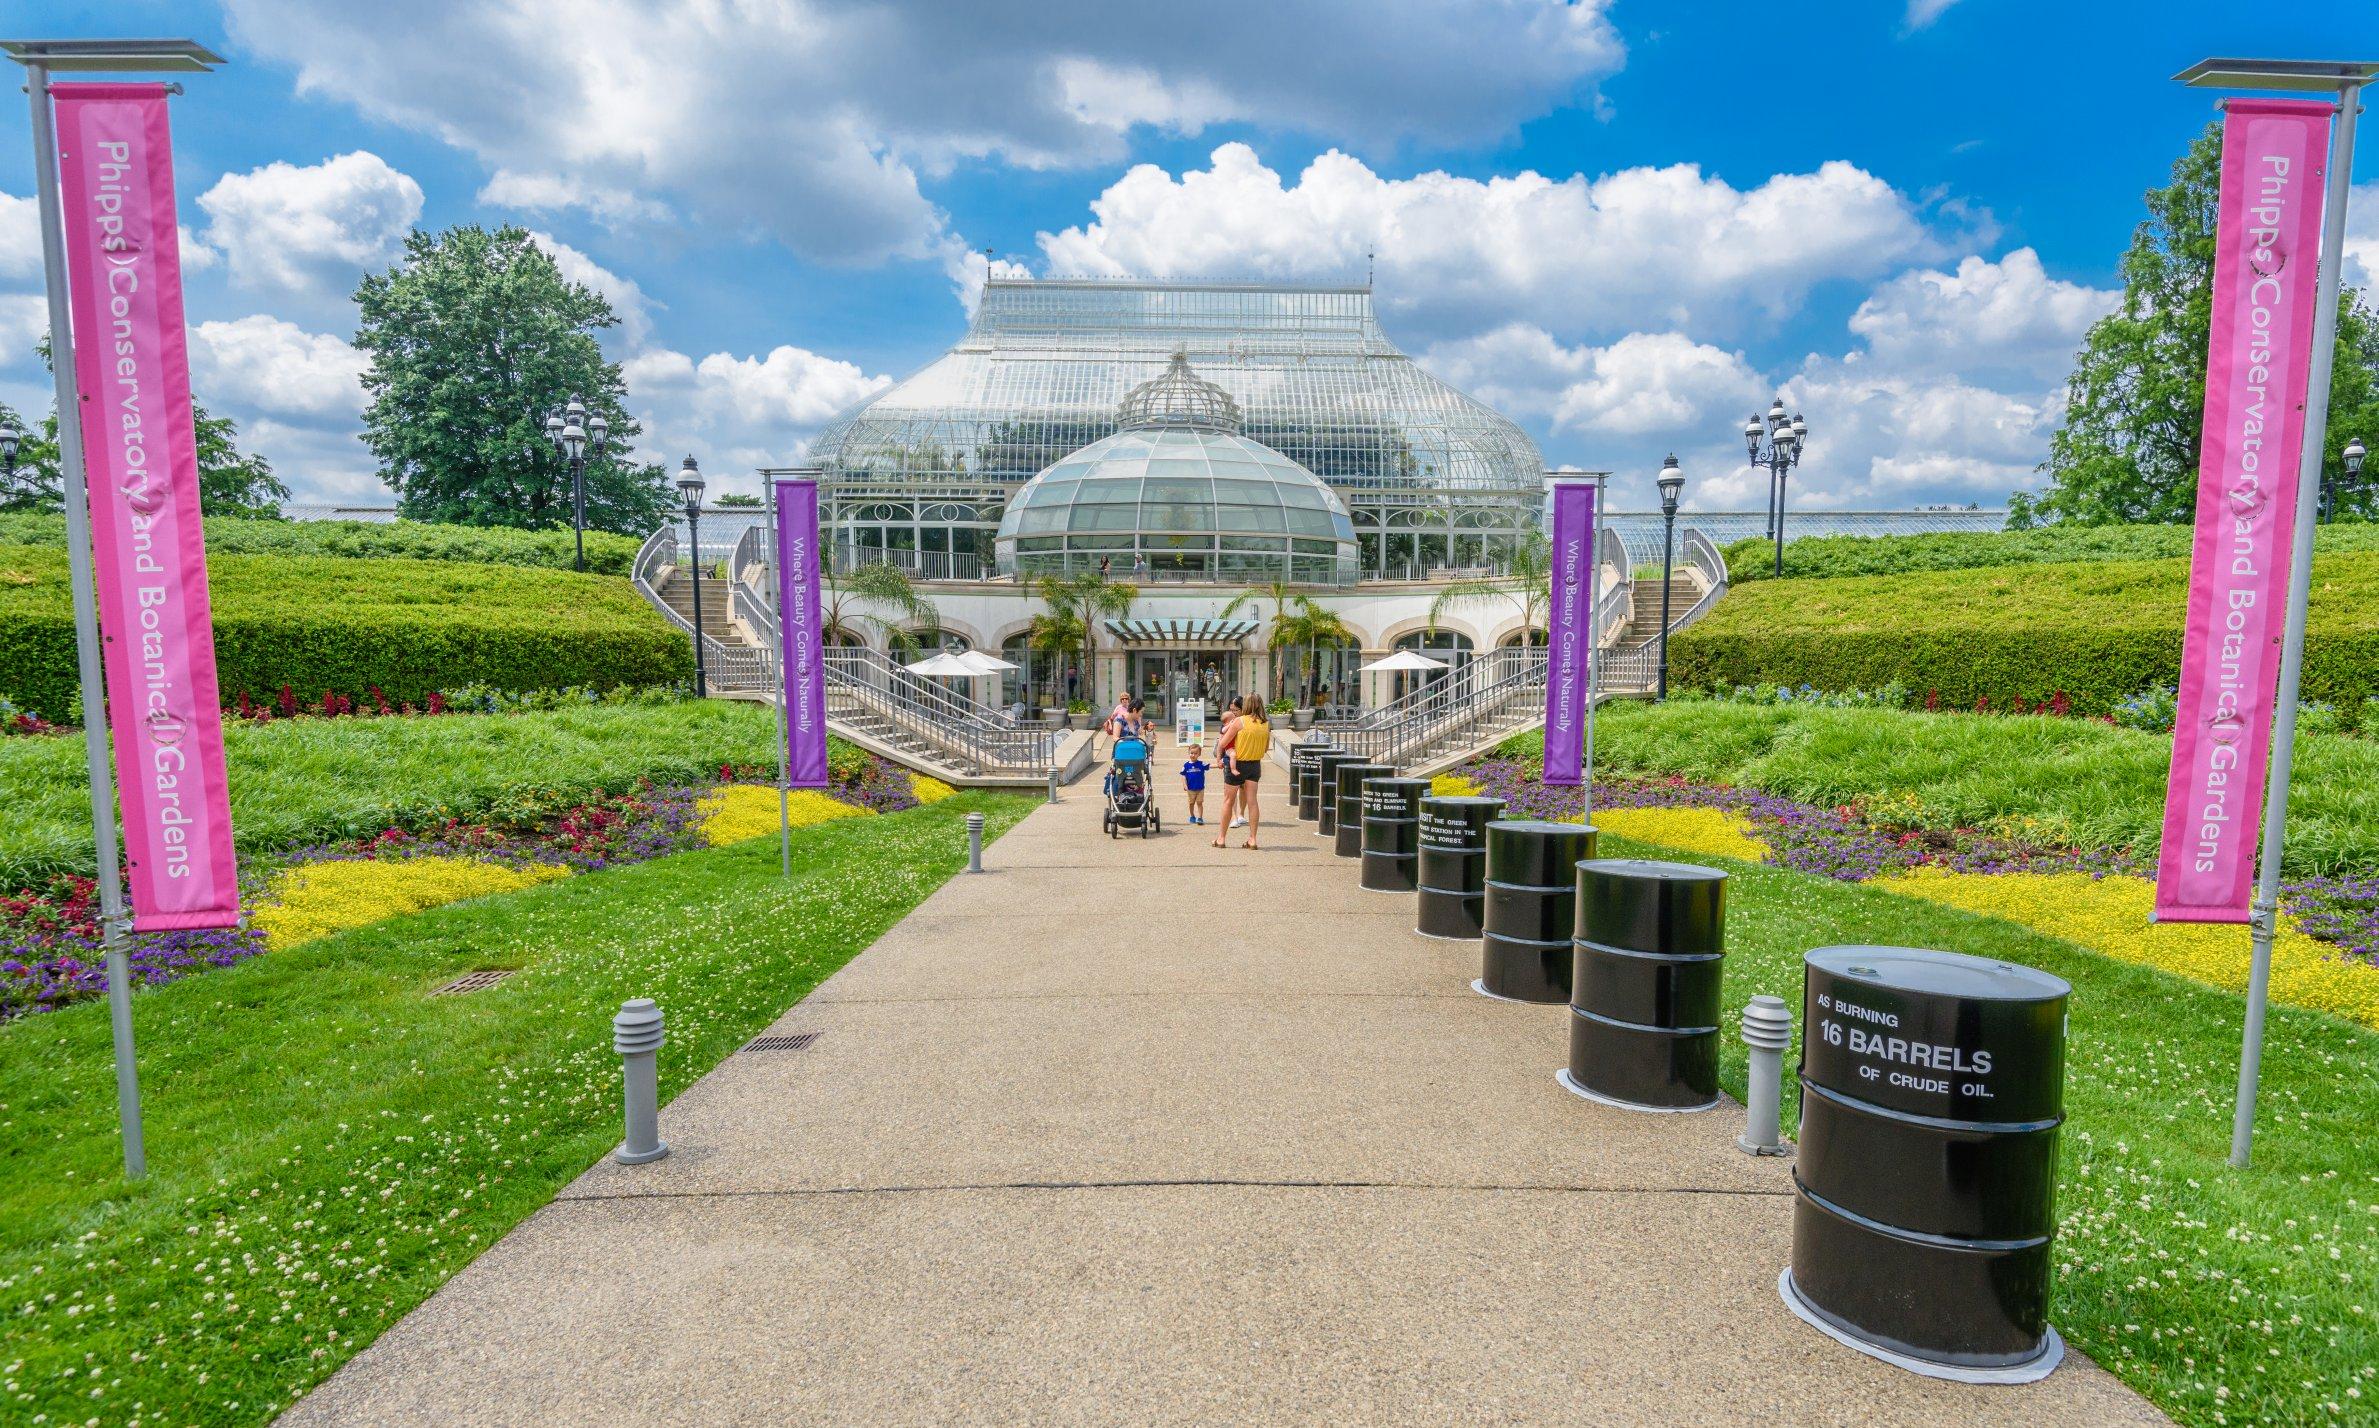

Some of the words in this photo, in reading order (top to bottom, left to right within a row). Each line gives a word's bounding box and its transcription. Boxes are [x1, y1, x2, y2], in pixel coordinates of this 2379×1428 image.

[95, 141, 130, 252] Phipps
[2249, 156, 2290, 262] Phipps
[108, 267, 150, 503] Conservatory
[2228, 278, 2281, 507] Conservatory
[130, 514, 164, 573] and
[792, 537, 804, 580] Where
[1566, 540, 1580, 583] Where
[2231, 520, 2258, 575] and
[792, 585, 807, 628] Beauty
[1561, 586, 1578, 629] Beauty
[137, 586, 182, 731] Botanical
[794, 631, 809, 675] Comes
[1560, 633, 1575, 675] Comes
[2213, 589, 2255, 731] Botanical
[796, 678, 811, 733] Naturally
[1556, 678, 1574, 734] Naturally
[153, 746, 193, 878] Gardens
[1372, 803, 1382, 811] 16
[1430, 826, 1453, 835] STATION
[2195, 745, 2238, 873] Gardens
[1438, 836, 1463, 844] FOREST.
[1817, 993, 1831, 1008] AS
[1835, 999, 1899, 1028] BURNING
[1821, 1019, 1843, 1046] 16
[1848, 1028, 1992, 1074] BARRELS
[1859, 1065, 1881, 1081] OF
[1889, 1072, 1949, 1094] CRUDE
[1961, 1083, 1994, 1098] OIL.
